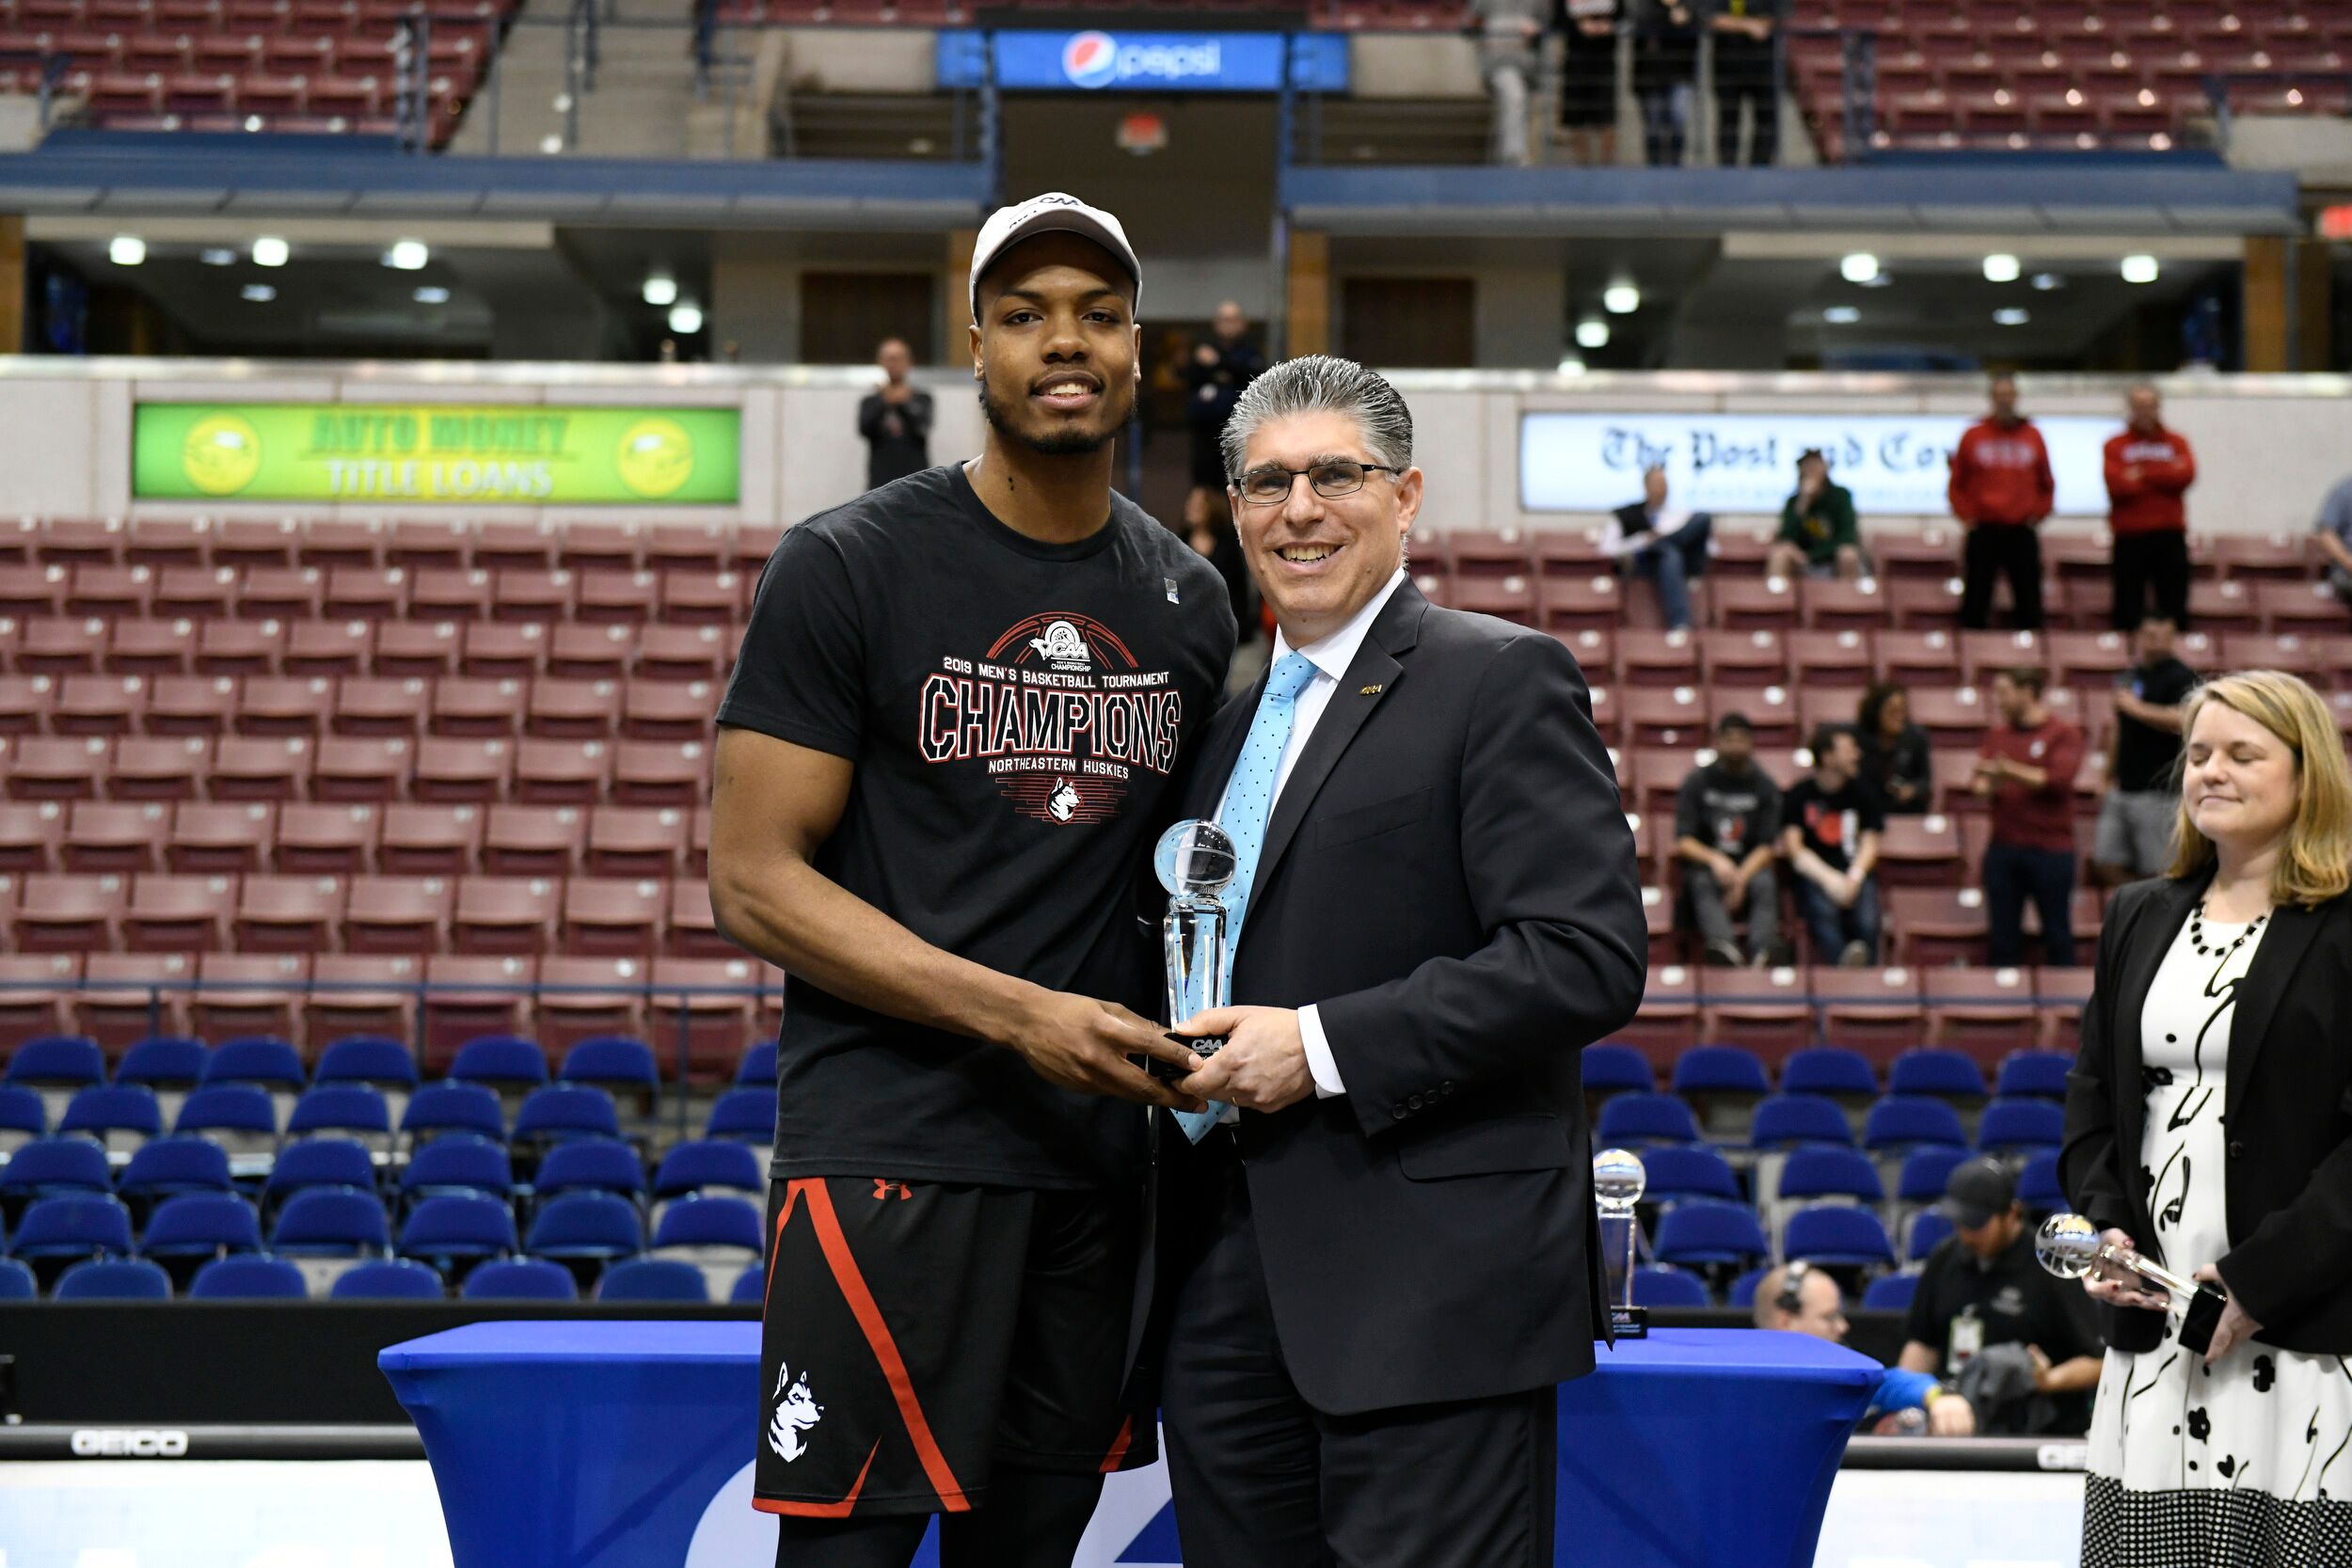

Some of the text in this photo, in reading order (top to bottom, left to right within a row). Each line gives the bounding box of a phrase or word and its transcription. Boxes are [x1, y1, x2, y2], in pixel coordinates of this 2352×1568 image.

[1117, 41, 1221, 80] pepsi
[314, 413, 569, 453] AUTO MONEY
[1691, 431, 1775, 472] Post
[327, 459, 552, 497] TITLE LOANS
[943, 656, 1169, 689] 2019 MEN'S BASKETBALL TOURNAMENT
[1051, 662, 1092, 673] CHAMPIONSHIP
[918, 672, 1183, 776] CHAMPIONS
[988, 756, 1129, 780] NORTHEASTERN HUSKIES
[1191, 1038, 1223, 1052] CAA
[71, 1429, 188, 1456] GEICO
